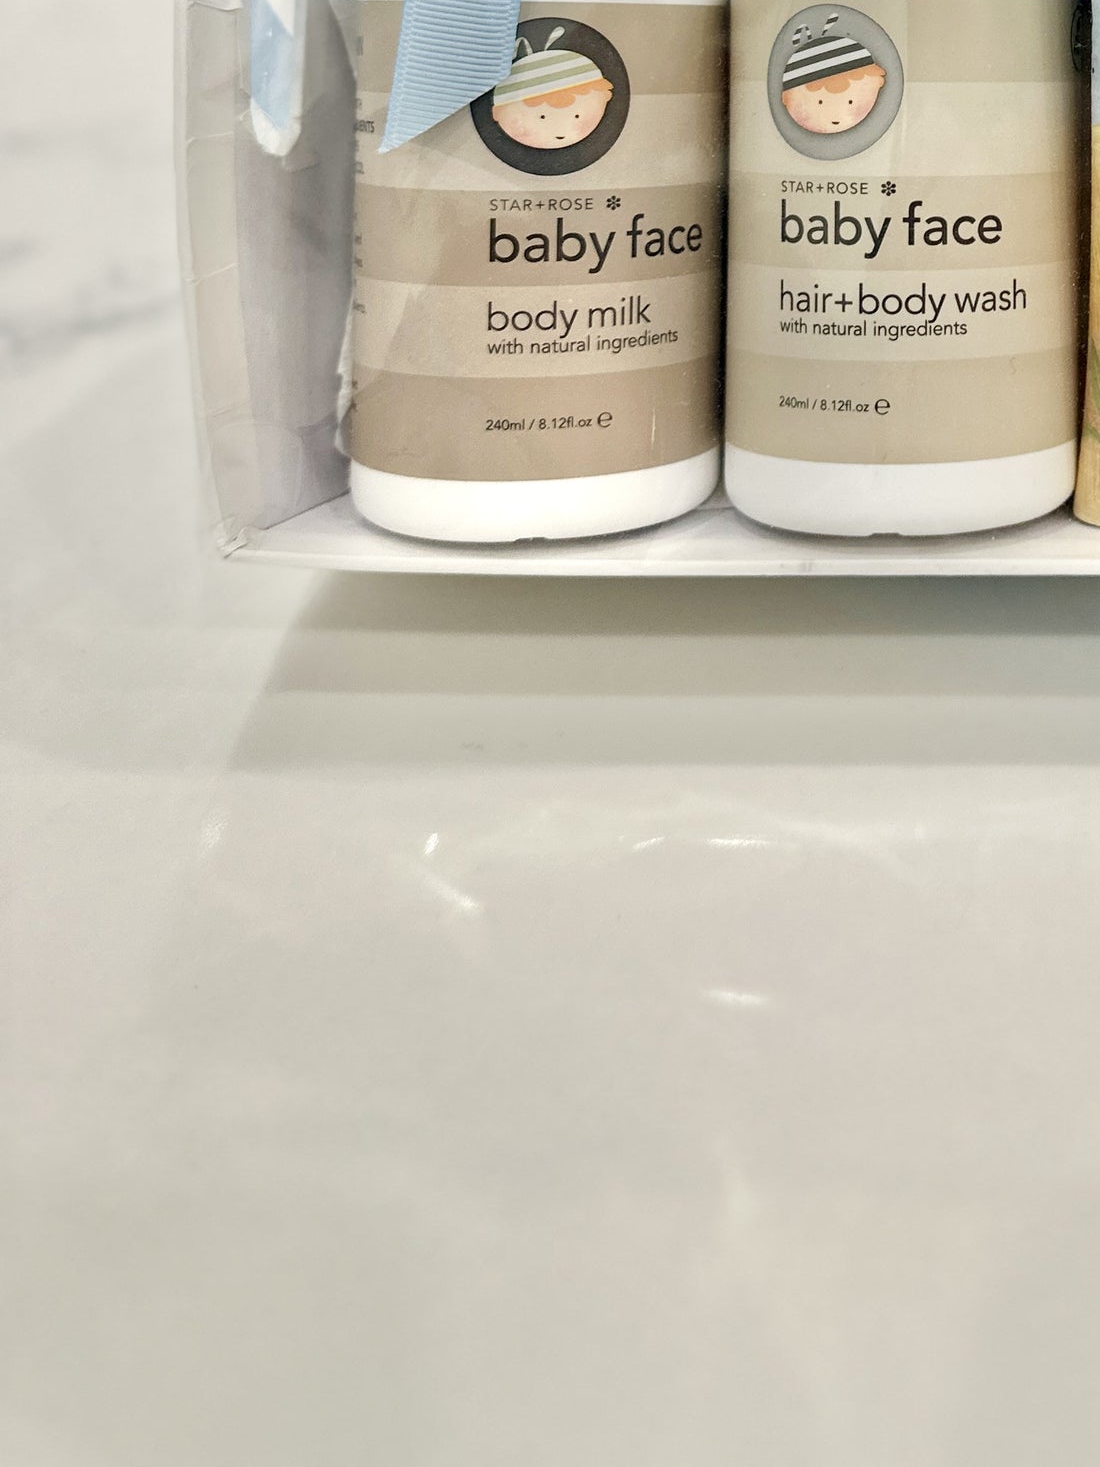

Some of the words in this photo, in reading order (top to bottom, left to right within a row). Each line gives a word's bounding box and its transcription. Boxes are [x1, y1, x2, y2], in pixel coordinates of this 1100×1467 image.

[780, 180, 869, 195] STAR+ROSE
[489, 197, 595, 211] STAR+ROSE
[781, 198, 892, 260] baby
[902, 200, 1004, 246] face
[488, 217, 617, 275] baby
[626, 213, 704, 259] face
[779, 278, 947, 324] hair+body
[954, 278, 1027, 314] wash
[487, 300, 579, 339] body
[588, 295, 652, 328] milk
[487, 337, 524, 355] with
[529, 335, 592, 355] natural
[597, 329, 679, 354] ingredients
[780, 318, 808, 334] with
[812, 319, 867, 337] natural
[872, 319, 968, 342] ingredients
[778, 395, 809, 410] 240ml
[485, 418, 526, 432] 240ml
